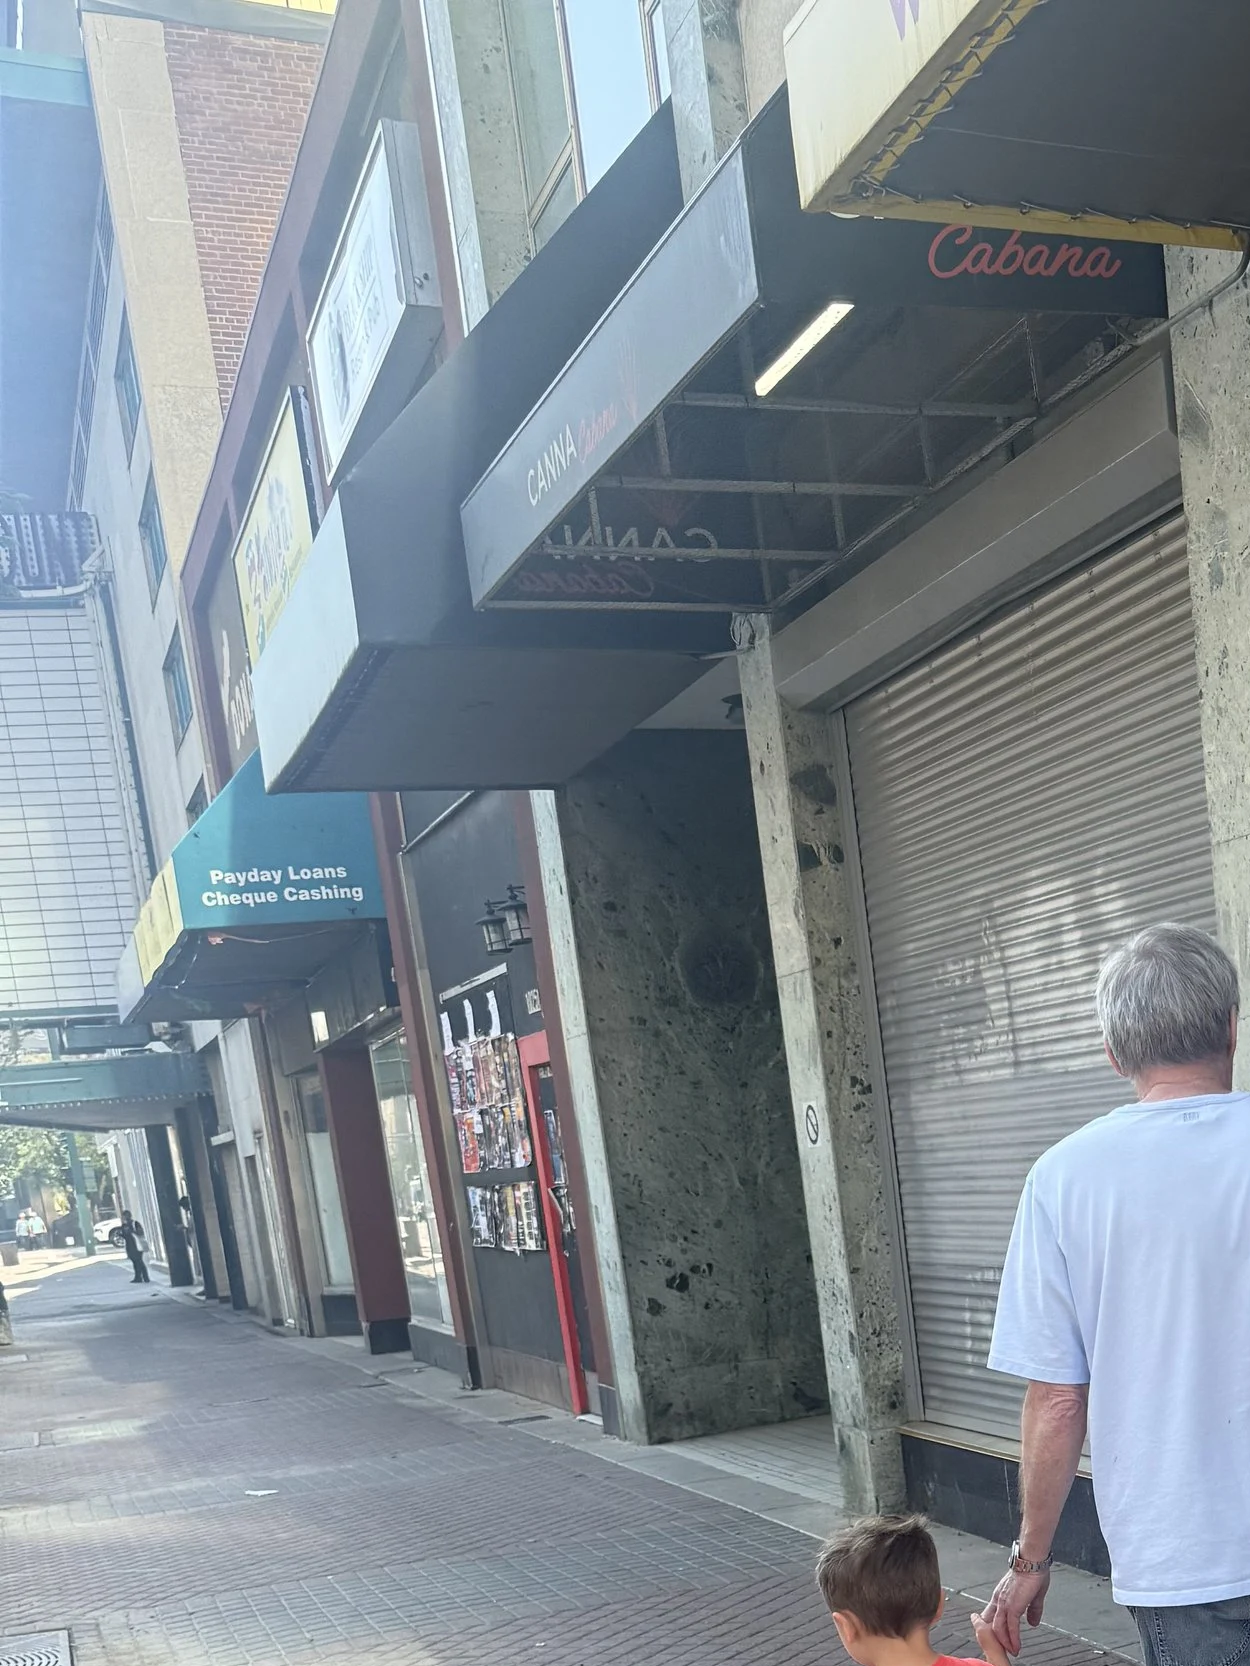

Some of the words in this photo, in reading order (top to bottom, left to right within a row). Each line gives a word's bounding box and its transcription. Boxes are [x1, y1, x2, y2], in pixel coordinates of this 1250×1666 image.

[928, 224, 1121, 278] Cabana
[527, 424, 577, 506] CANNA
[209, 868, 282, 887] Payday
[288, 866, 347, 880] Loans
[202, 889, 278, 907] Cheque
[283, 885, 363, 902] Cashing
